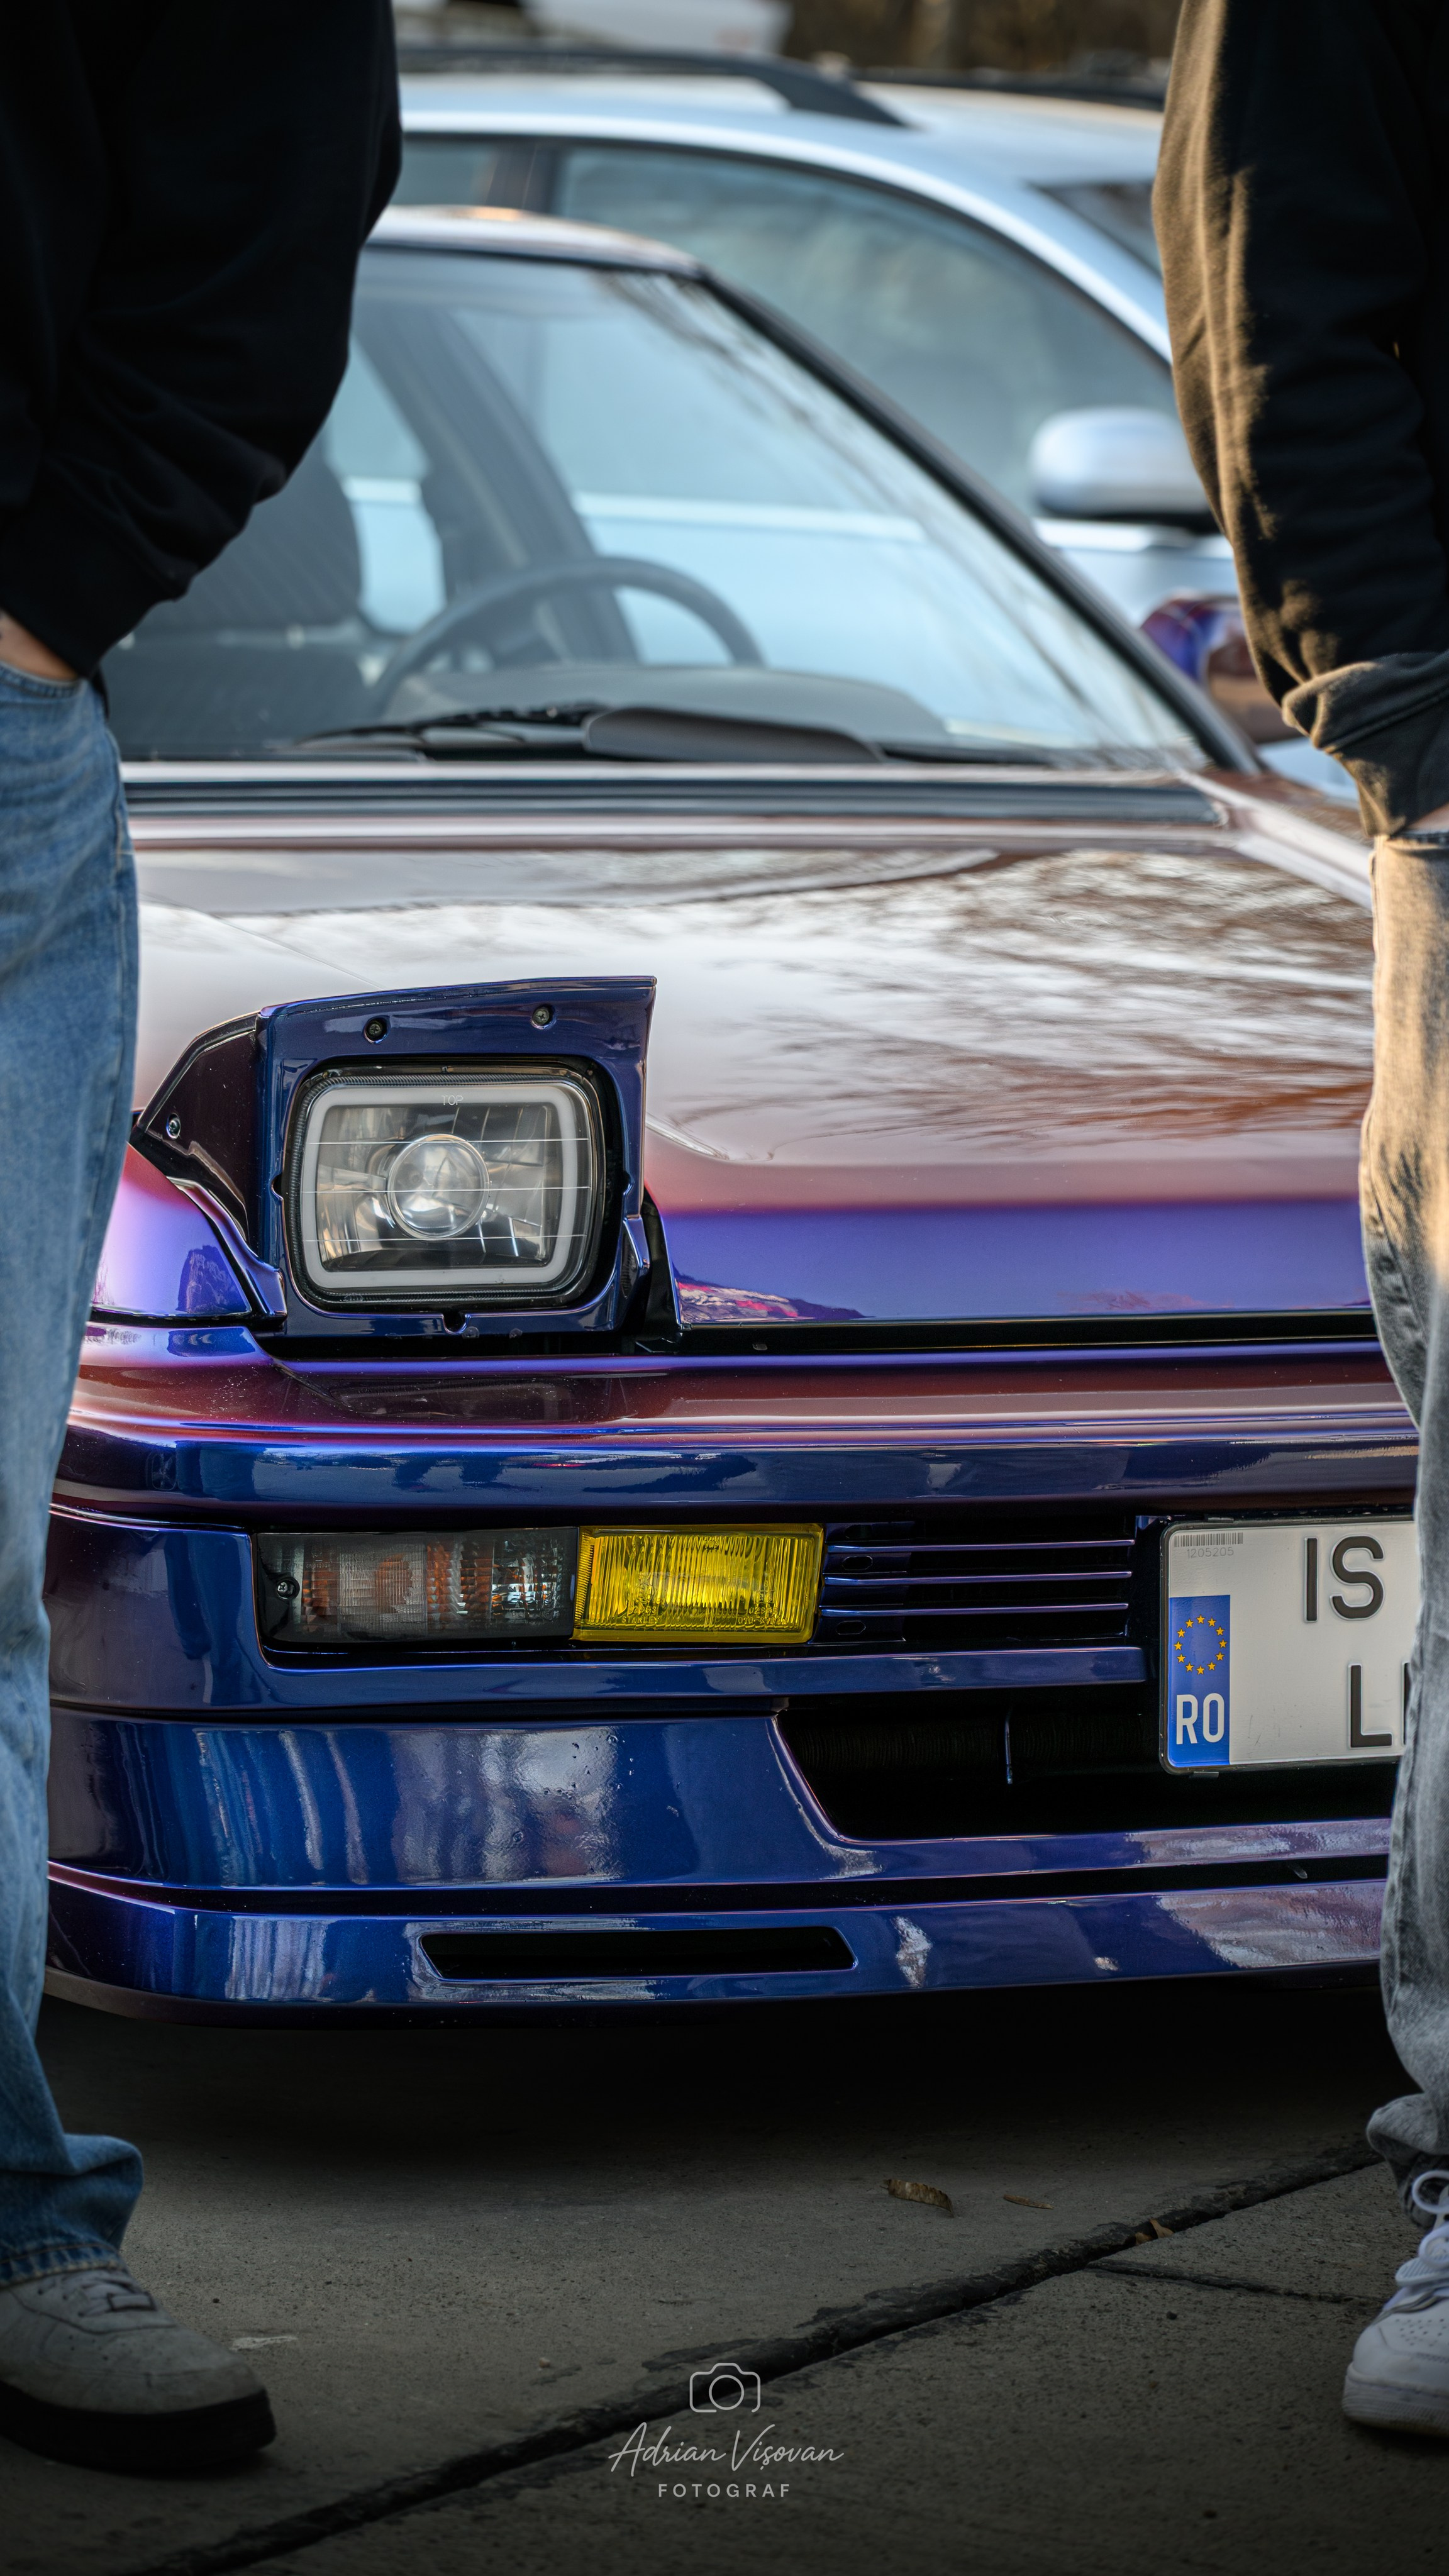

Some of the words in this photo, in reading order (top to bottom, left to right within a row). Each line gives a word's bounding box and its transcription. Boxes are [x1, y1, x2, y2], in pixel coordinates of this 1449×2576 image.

[441, 1094, 464, 1106] TOP
[1186, 1546, 1235, 1559] 1205205
[1304, 1535, 1385, 1623] IS
[1175, 1692, 1226, 1745] RO
[1350, 1662, 1411, 1748] L
